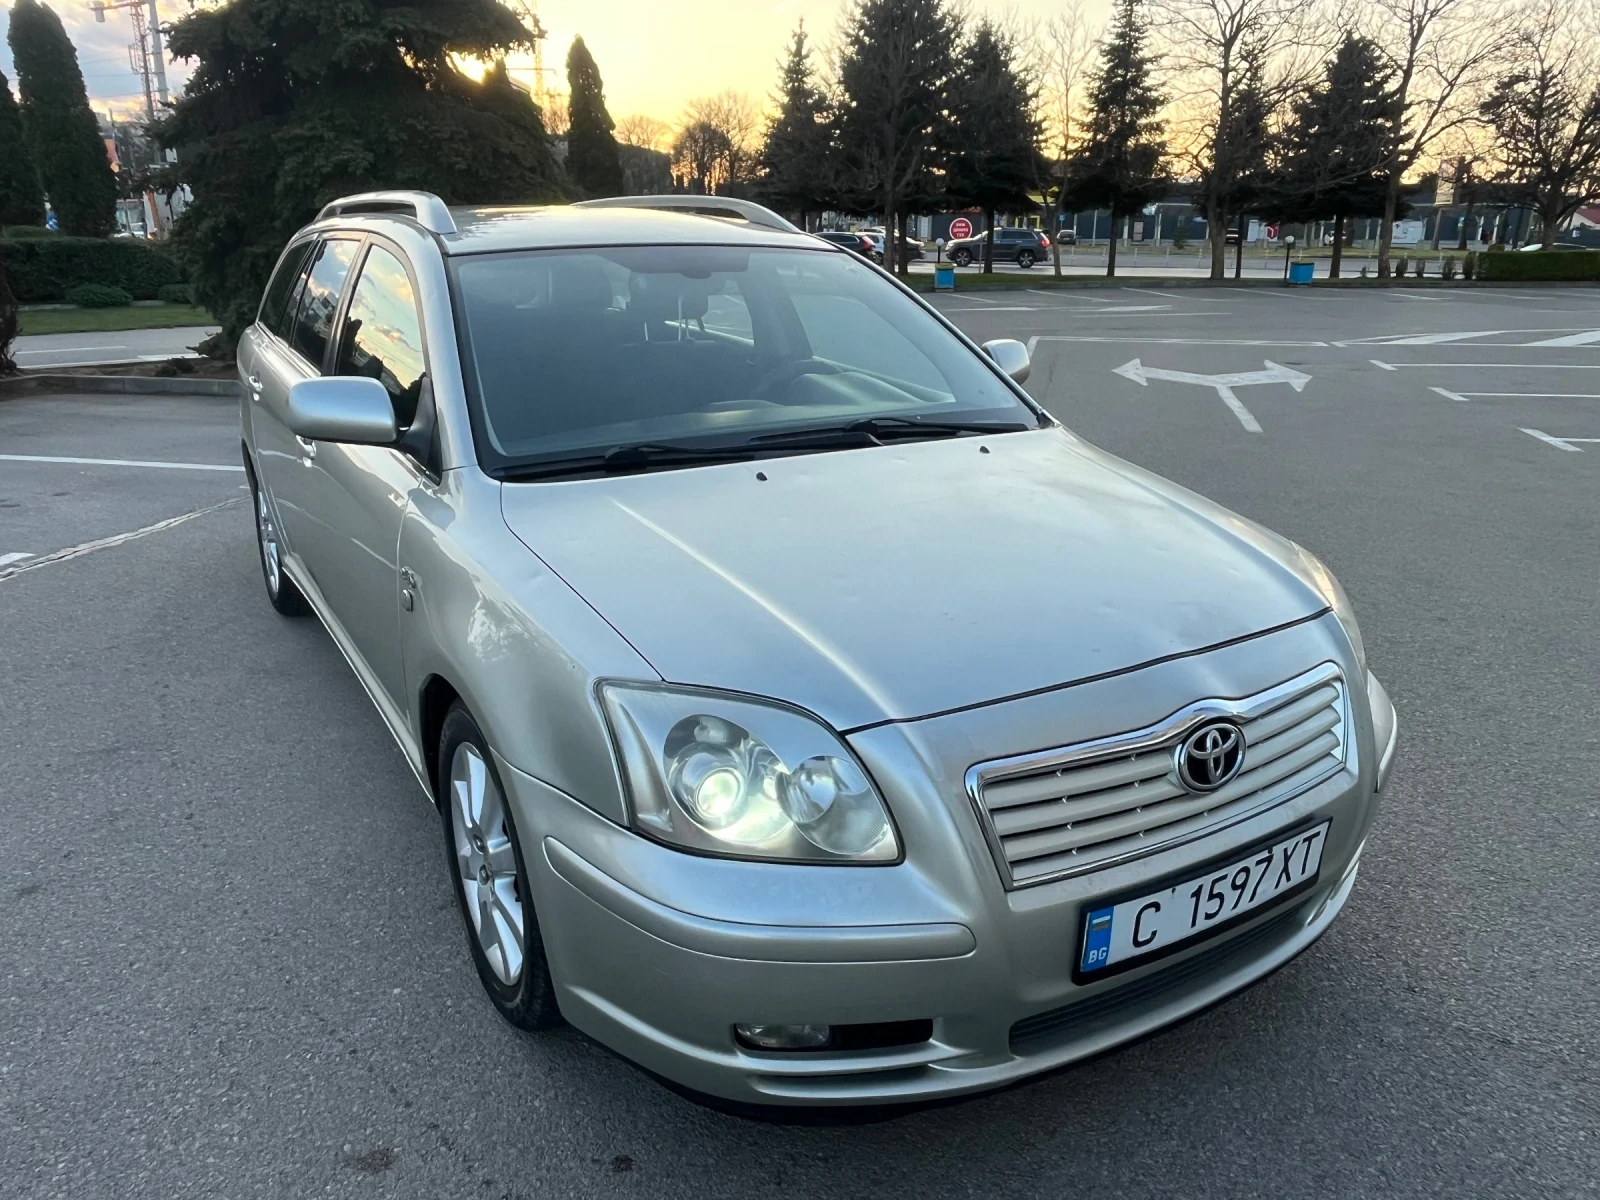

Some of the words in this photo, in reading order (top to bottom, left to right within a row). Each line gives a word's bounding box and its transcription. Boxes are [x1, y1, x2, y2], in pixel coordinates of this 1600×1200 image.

[1132, 901, 1161, 948] C
[1190, 853, 1274, 928] 1597
[1274, 831, 1320, 890] XT
[1087, 946, 1107, 964] BG
